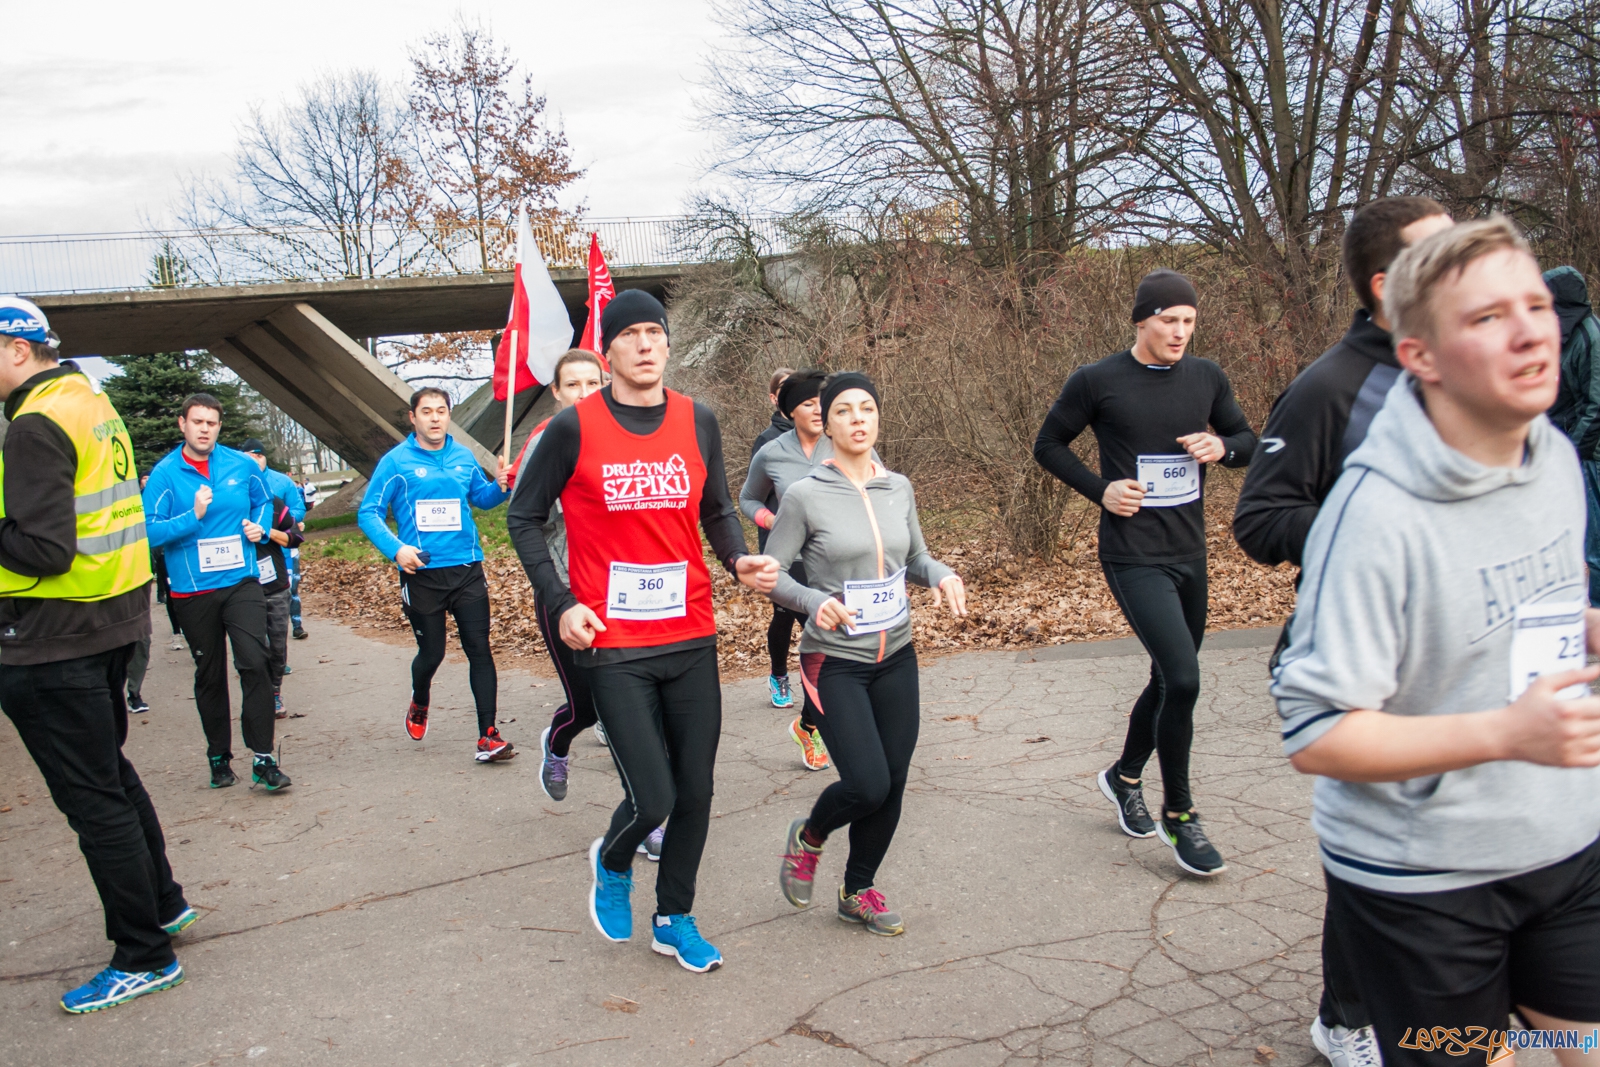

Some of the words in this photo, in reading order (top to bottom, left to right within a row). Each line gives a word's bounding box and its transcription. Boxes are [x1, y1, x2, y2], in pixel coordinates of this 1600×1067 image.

[602, 459, 675, 477] DRUŻYNA
[1163, 466, 1186, 479] 660
[603, 475, 690, 501] SZPIKU
[431, 506, 447, 515] 692
[607, 500, 687, 512] www.darszpiku.pl
[215, 546, 230, 555] 781
[638, 578, 664, 590] 360
[872, 588, 894, 604] 226
